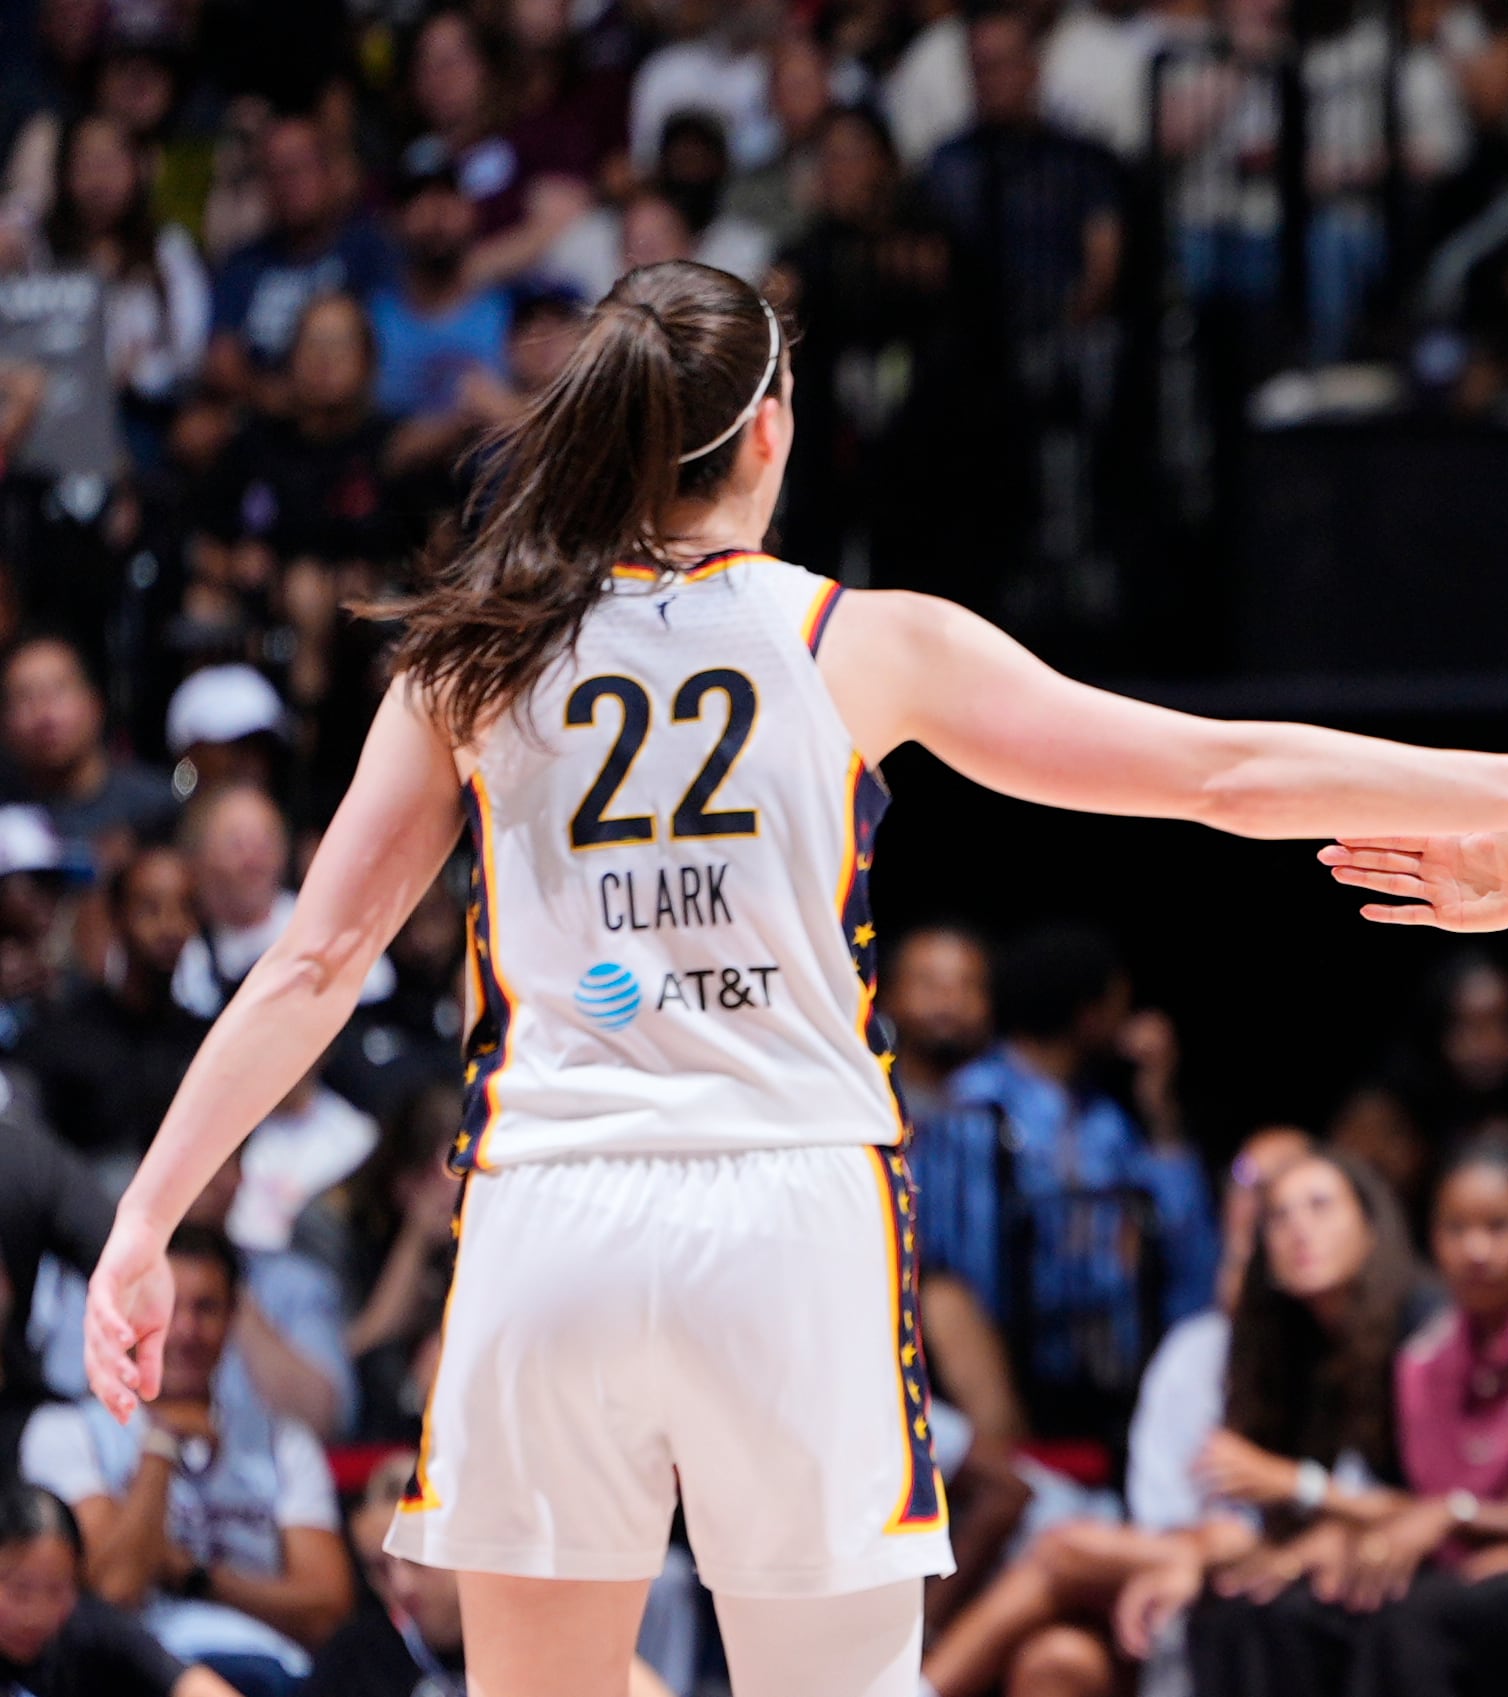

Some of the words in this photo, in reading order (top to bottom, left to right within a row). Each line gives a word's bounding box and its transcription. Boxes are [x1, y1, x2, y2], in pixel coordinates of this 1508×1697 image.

[563, 667, 761, 853] 22
[600, 863, 733, 933] CLARK
[655, 965, 780, 1013] AT&T
